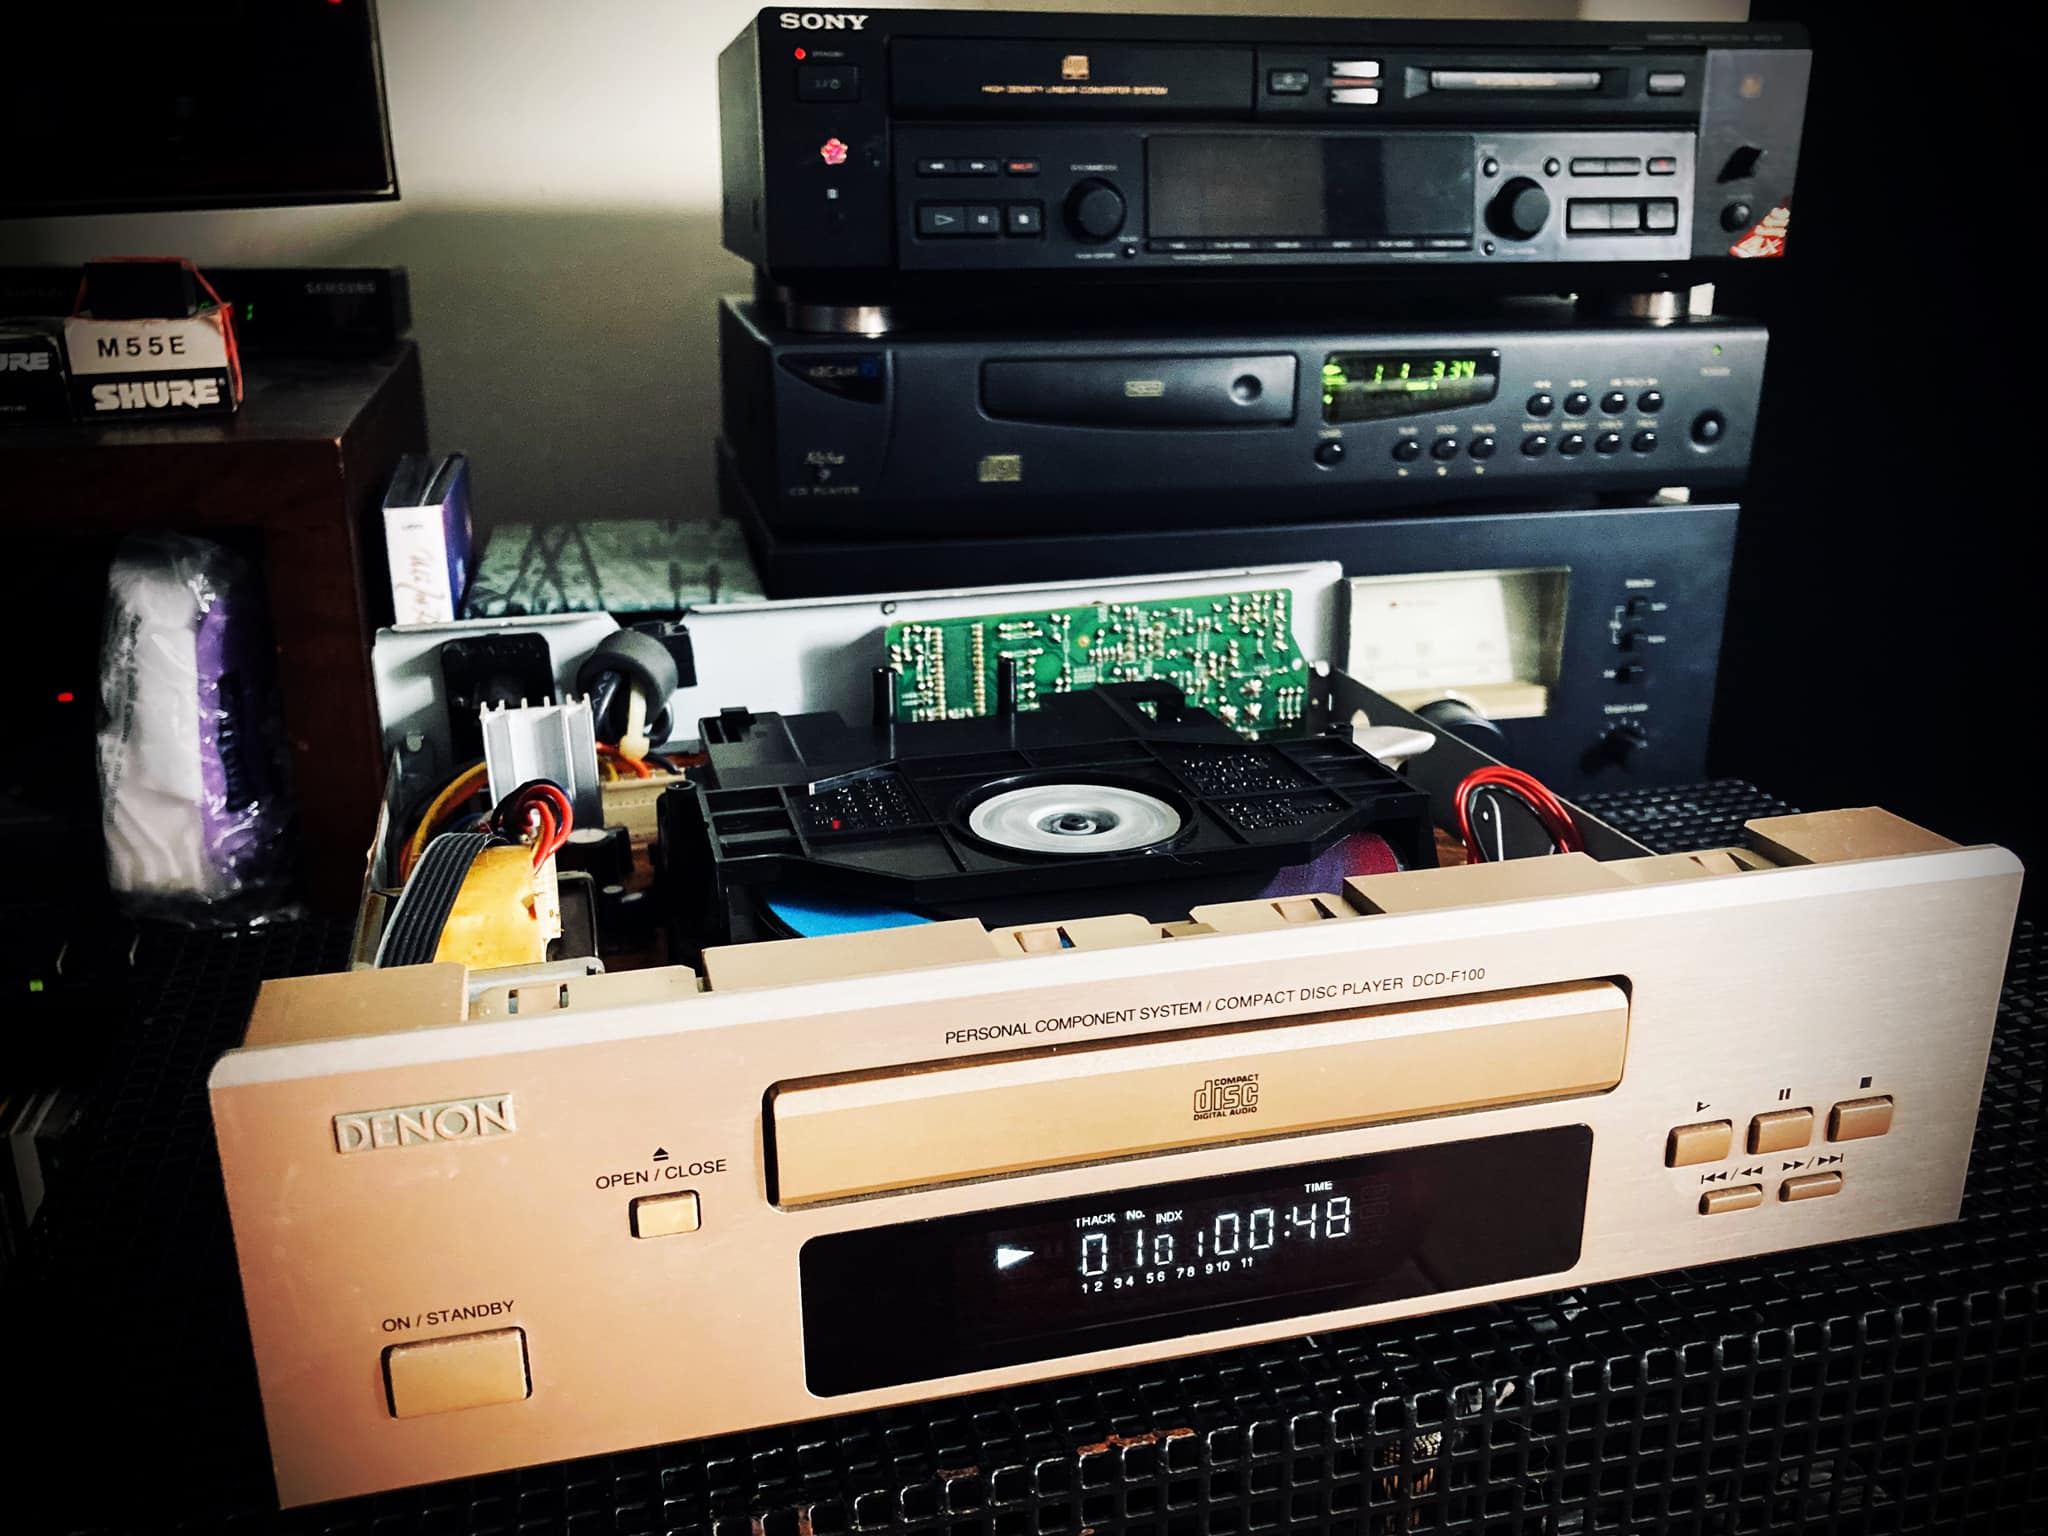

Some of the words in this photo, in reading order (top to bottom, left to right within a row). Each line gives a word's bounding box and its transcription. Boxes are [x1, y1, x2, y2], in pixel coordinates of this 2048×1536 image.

[780, 12, 869, 30] SONY
[97, 335, 186, 357] M55E
[92, 377, 220, 410] SHURE
[945, 1023, 1031, 1044] PERSONAL
[1035, 1008, 1136, 1033] COMPONENT
[1139, 1000, 1202, 1020] SYSTEM
[1215, 990, 1296, 1011] COMPACT
[1300, 985, 1337, 1001] DISC
[1342, 977, 1404, 996] PLAYER
[1412, 967, 1486, 988] DCD-F100
[1214, 1074, 1259, 1086] COMPACT
[335, 1095, 516, 1153] DENON
[1194, 1111, 1227, 1121] DIGITAL
[1230, 1106, 1258, 1115] AUDIO
[595, 1170, 649, 1189] OPEN
[665, 1159, 727, 1179] CLOSE
[1304, 1181, 1333, 1193] TIME
[1156, 1210, 1183, 1225] INDX
[382, 1316, 411, 1332] ON
[427, 1300, 514, 1326] STANDBY
